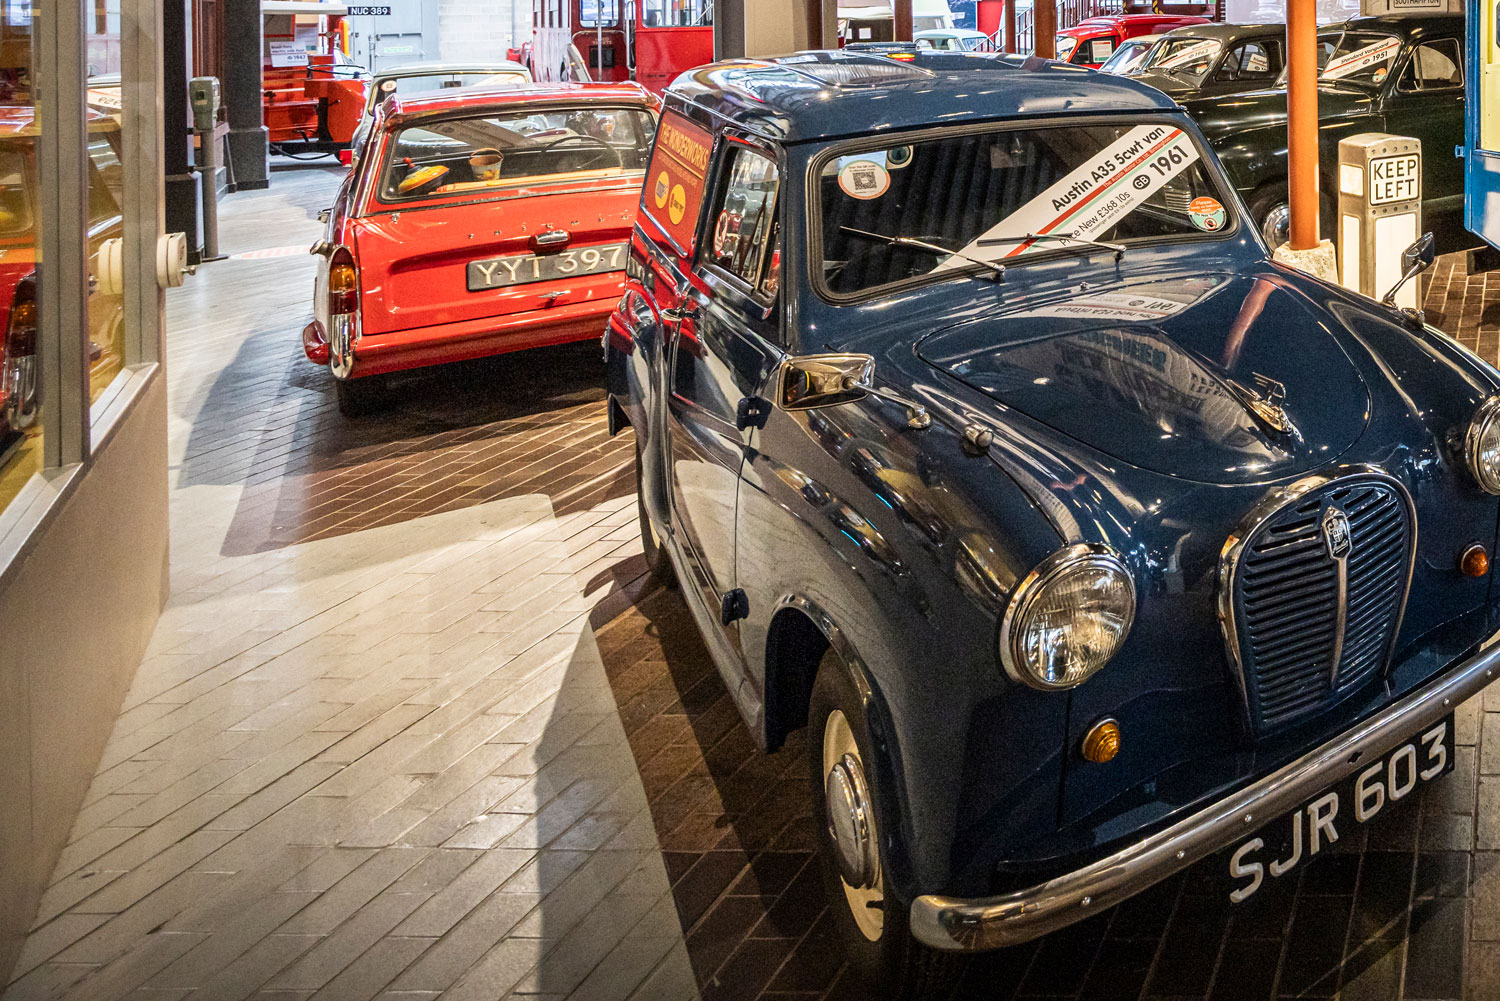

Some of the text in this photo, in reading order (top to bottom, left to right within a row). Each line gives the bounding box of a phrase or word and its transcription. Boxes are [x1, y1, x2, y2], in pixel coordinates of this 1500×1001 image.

[351, 7, 388, 15] NUC 389
[1341, 42, 1389, 64] Standard Vanguard
[1371, 50, 1389, 62] 1951
[660, 122, 672, 145] THE
[1051, 126, 1166, 212] Austin A35 5cwt van
[1149, 144, 1189, 177] 1961
[1373, 159, 1416, 181] KEEP
[1111, 171, 1125, 183] Austin
[1123, 162, 1136, 173] Motor
[1375, 178, 1415, 200] LEFT
[1078, 215, 1099, 232] New
[1096, 199, 1119, 218] £368
[1115, 191, 1132, 205] 10s
[476, 245, 622, 285] YYT 397
[1229, 721, 1447, 904] SJR 603
